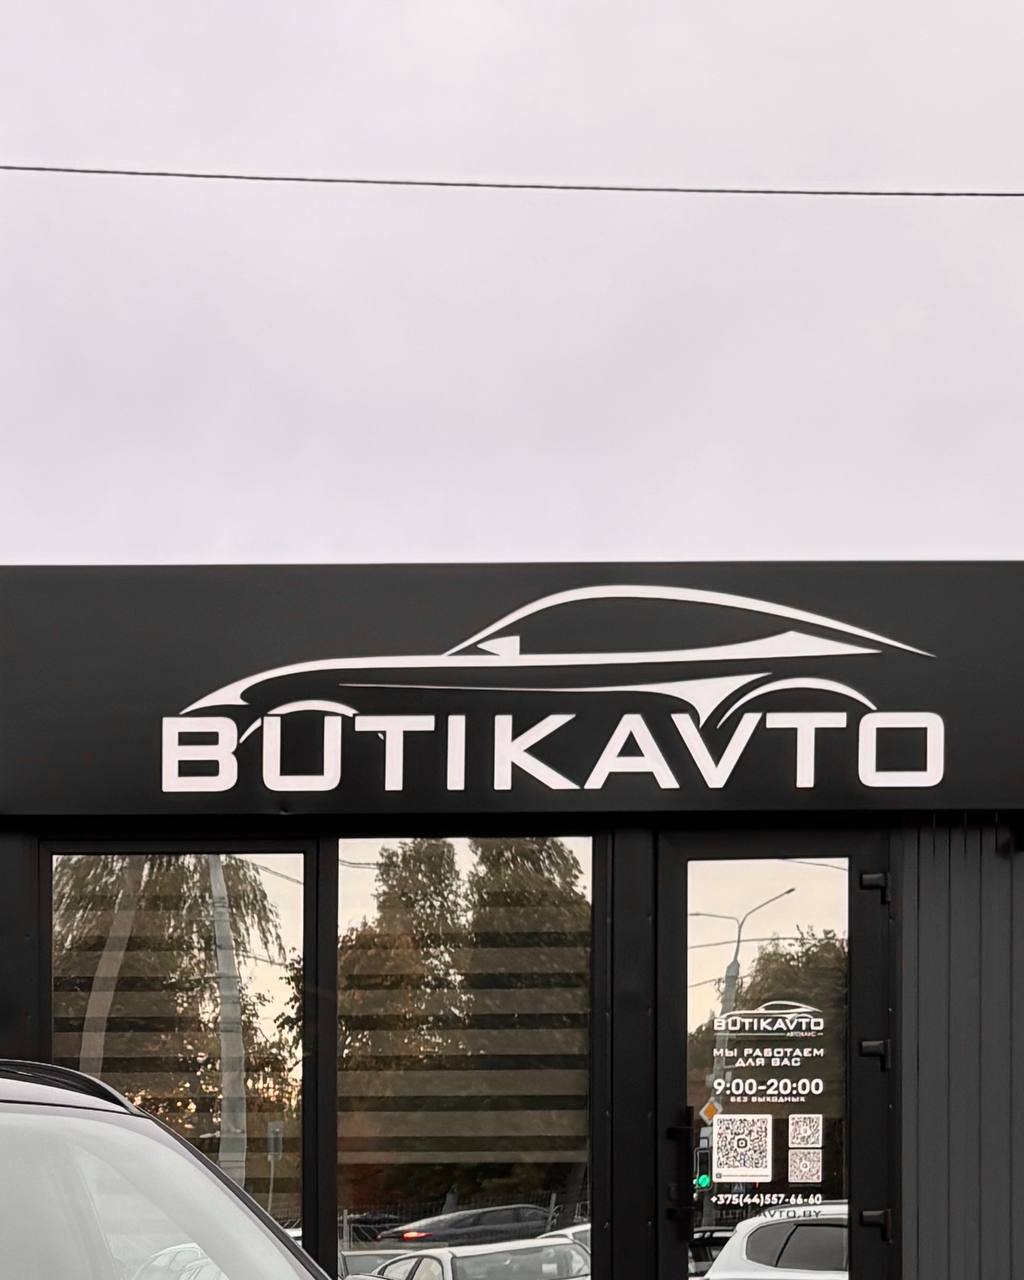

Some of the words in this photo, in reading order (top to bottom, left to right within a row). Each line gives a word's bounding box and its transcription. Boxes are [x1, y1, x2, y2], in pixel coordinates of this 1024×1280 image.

[161, 711, 946, 793] BUTIKAVTO
[713, 1017, 824, 1031] BUTIKAVTO
[713, 1048, 738, 1057] МЫ
[743, 1048, 824, 1058] РАБОТАЕМ
[734, 1057, 765, 1067] ДЛЯ
[771, 1057, 801, 1067] ВАС
[713, 1077, 824, 1096] 9:00-20:00
[710, 1193, 823, 1207] +375(44)557-66-60
